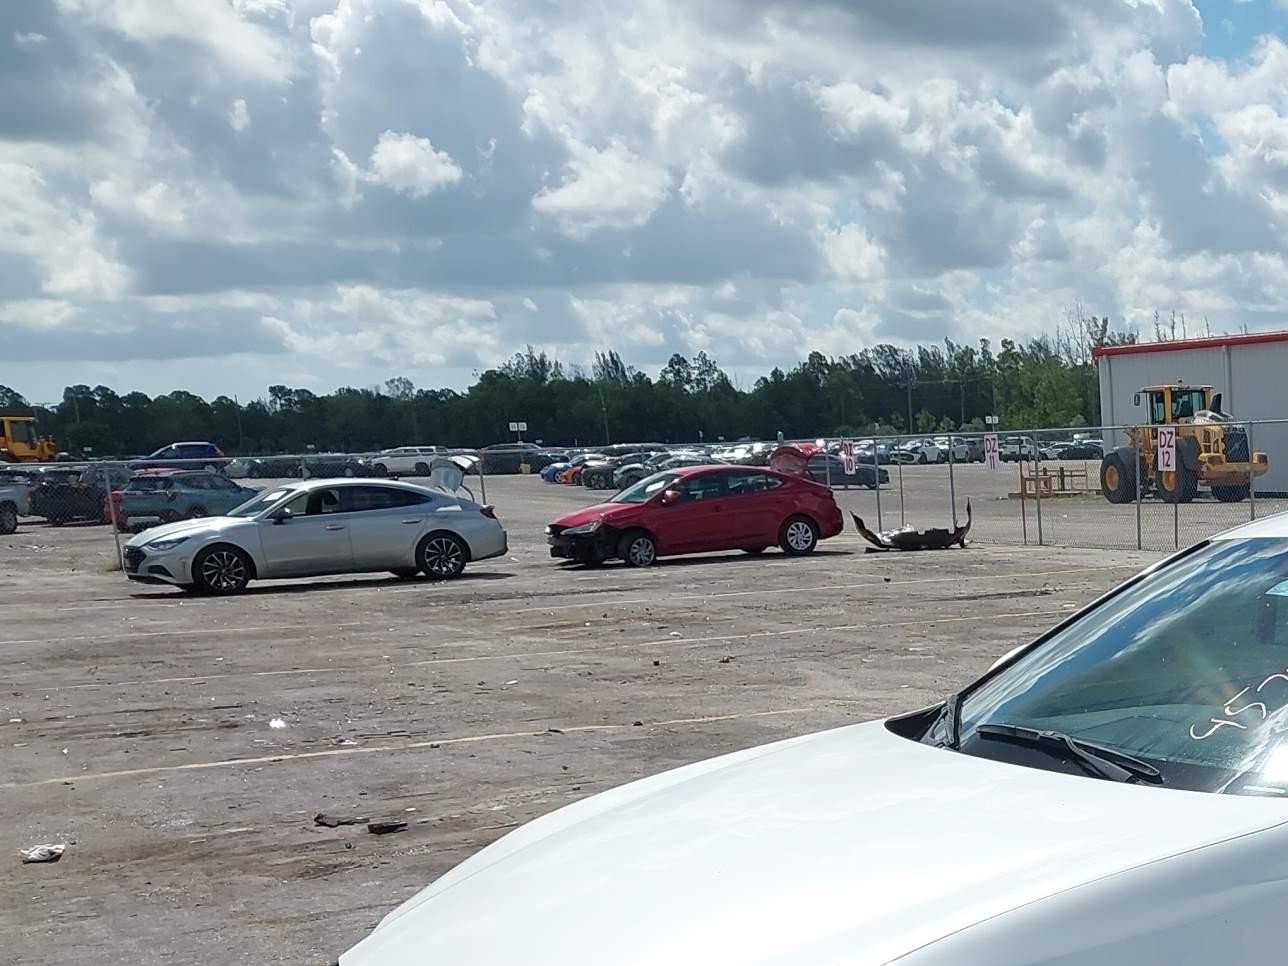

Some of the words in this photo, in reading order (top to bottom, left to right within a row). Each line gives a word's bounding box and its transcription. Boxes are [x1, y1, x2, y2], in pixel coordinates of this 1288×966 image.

[986, 437, 997, 454] DZ
[1160, 430, 1175, 449] DZ
[845, 458, 854, 471] 10
[1161, 450, 1171, 468] 12
